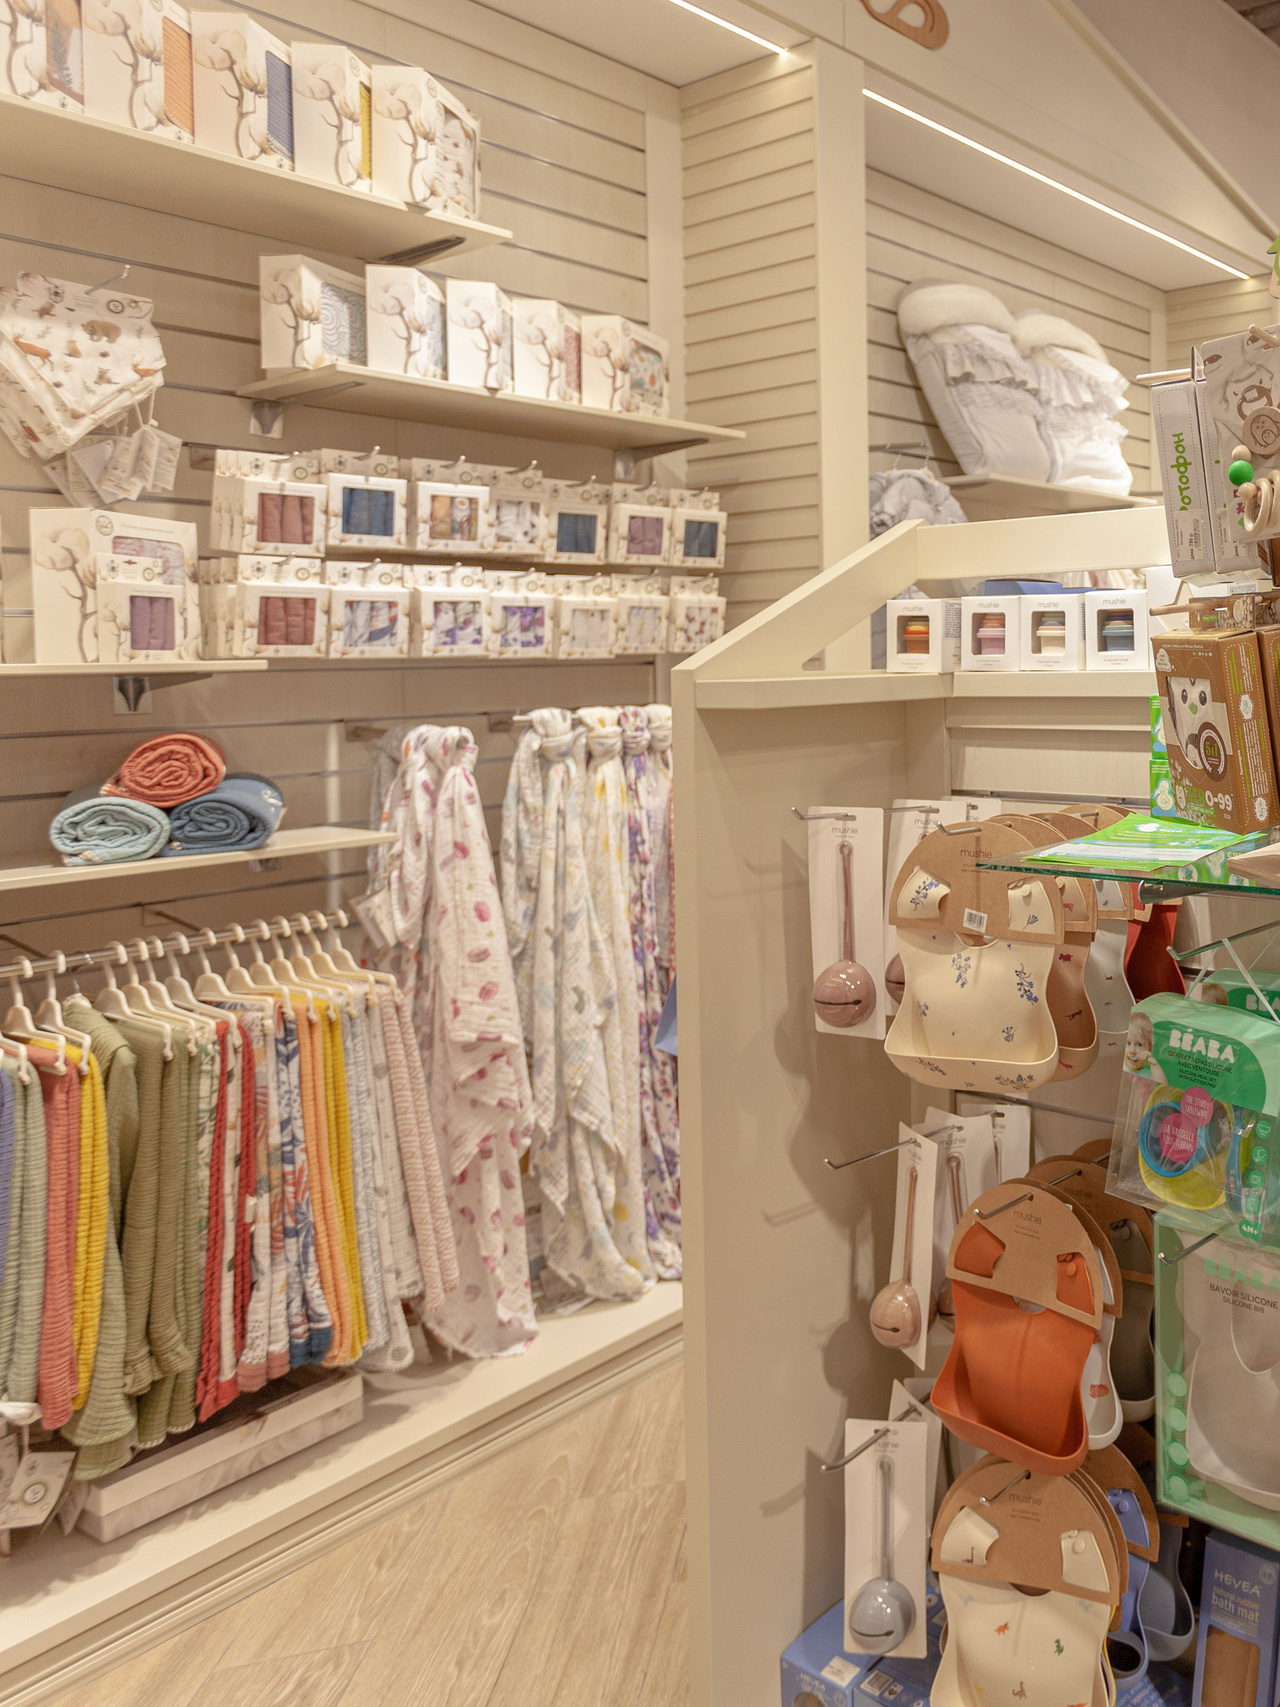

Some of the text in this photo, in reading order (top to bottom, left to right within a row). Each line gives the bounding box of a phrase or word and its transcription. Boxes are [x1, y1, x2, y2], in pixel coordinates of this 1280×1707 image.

[902, 605, 924, 613] mushie
[1103, 597, 1127, 606] mushie
[832, 826, 858, 834] mushie
[960, 848, 993, 859] mushie
[1169, 1028, 1235, 1064] BÉABA
[1013, 1210, 1043, 1226] mushie
[1242, 1224, 1258, 1236] 4M+
[1209, 1283, 1279, 1310] BAVOIR SILICONE
[1223, 1296, 1265, 1314] SILICONE BIB
[1214, 1568, 1261, 1598] HEVEA
[1211, 1592, 1260, 1622] bath mat
